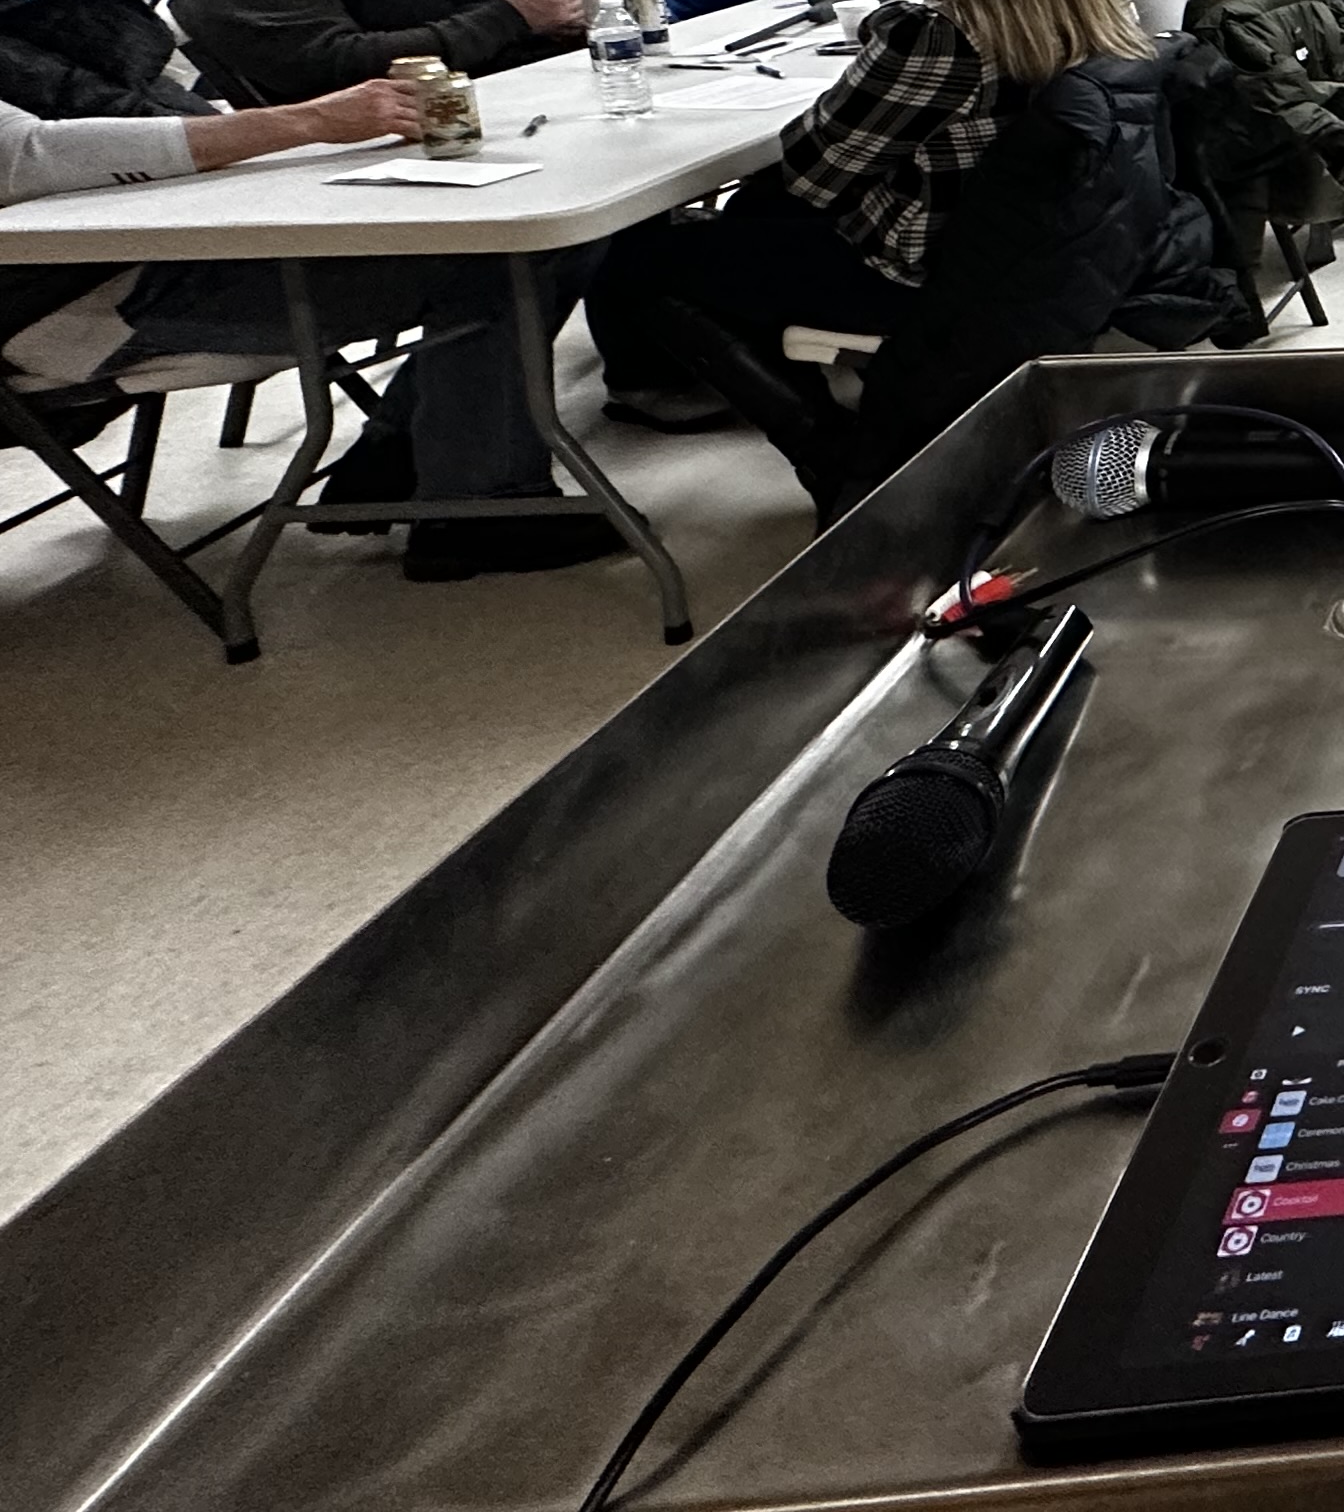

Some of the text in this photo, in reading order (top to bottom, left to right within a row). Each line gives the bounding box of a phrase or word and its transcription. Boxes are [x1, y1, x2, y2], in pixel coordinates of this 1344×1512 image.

[1295, 985, 1331, 994] SYNC
[1309, 1094, 1335, 1106] Cake
[1286, 1159, 1340, 1171] Christmas
[1260, 1231, 1307, 1244] Country
[1246, 1270, 1283, 1283] Latest
[1231, 1308, 1299, 1324] Line Dance
